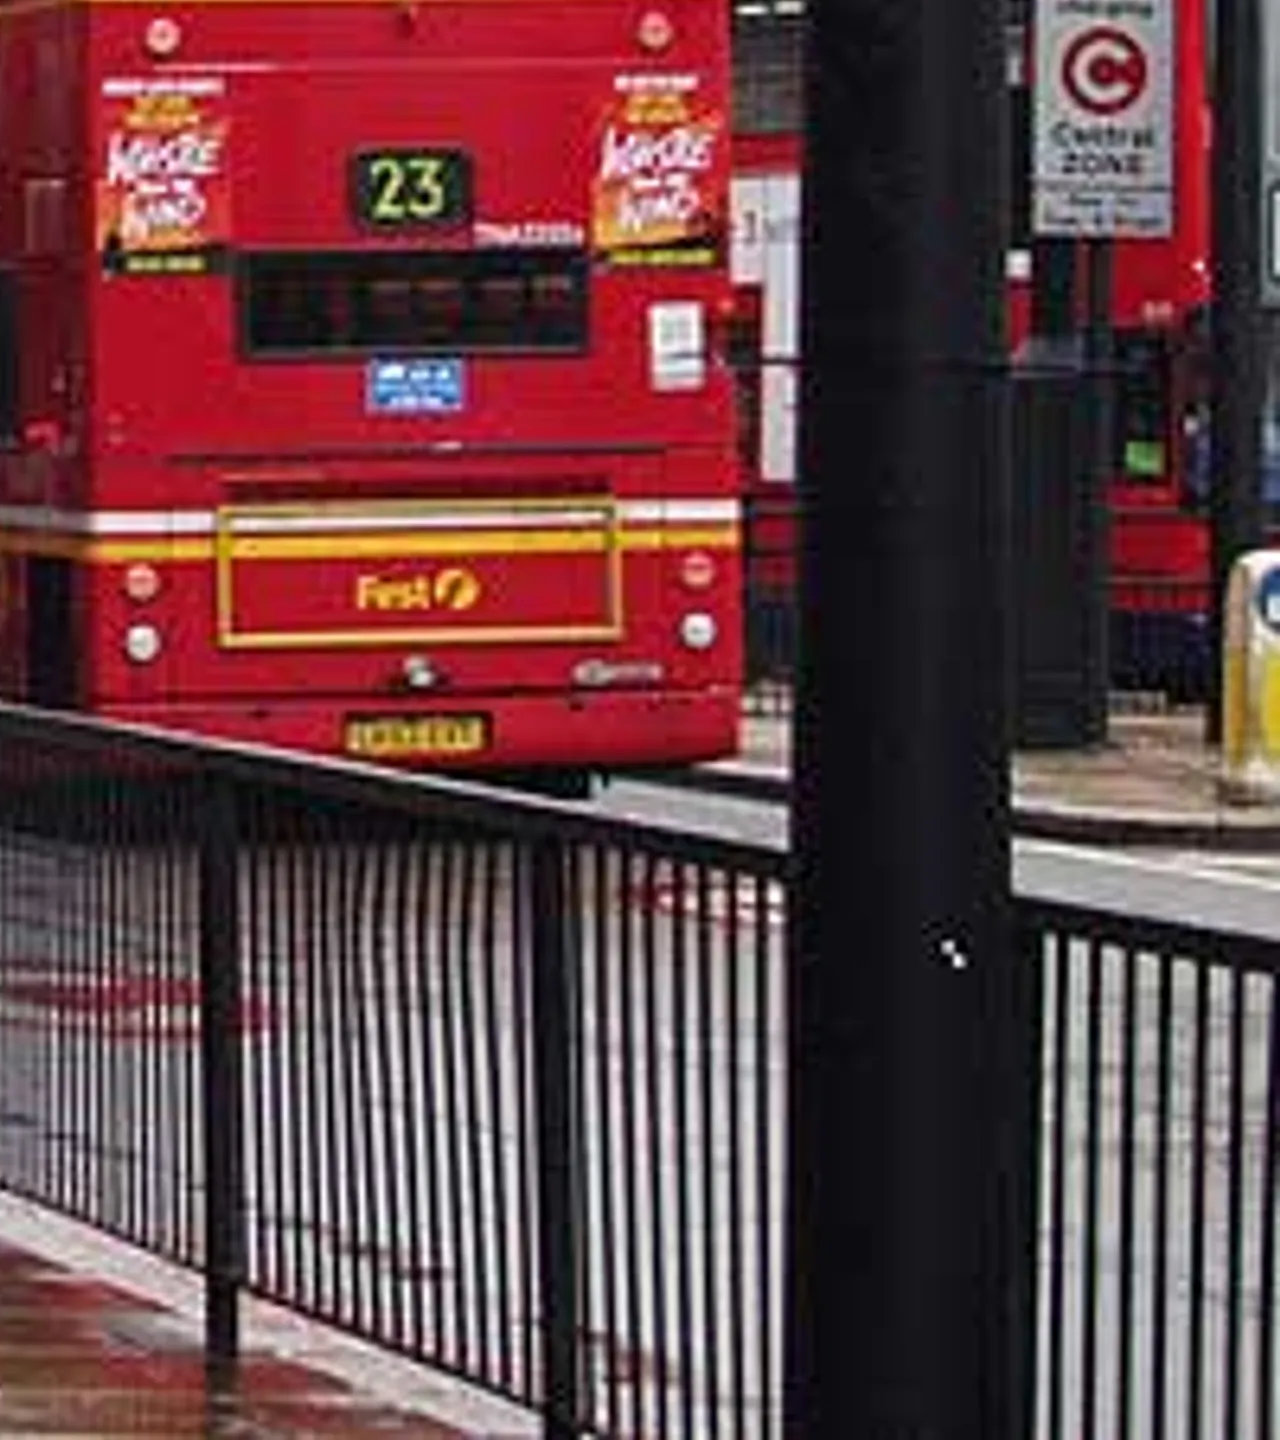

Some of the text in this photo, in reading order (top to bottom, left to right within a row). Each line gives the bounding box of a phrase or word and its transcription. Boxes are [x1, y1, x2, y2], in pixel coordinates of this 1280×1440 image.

[1050, 121, 1154, 148] Central
[1061, 152, 1143, 175] ZONE
[370, 158, 444, 220] 23
[357, 575, 430, 610] First
